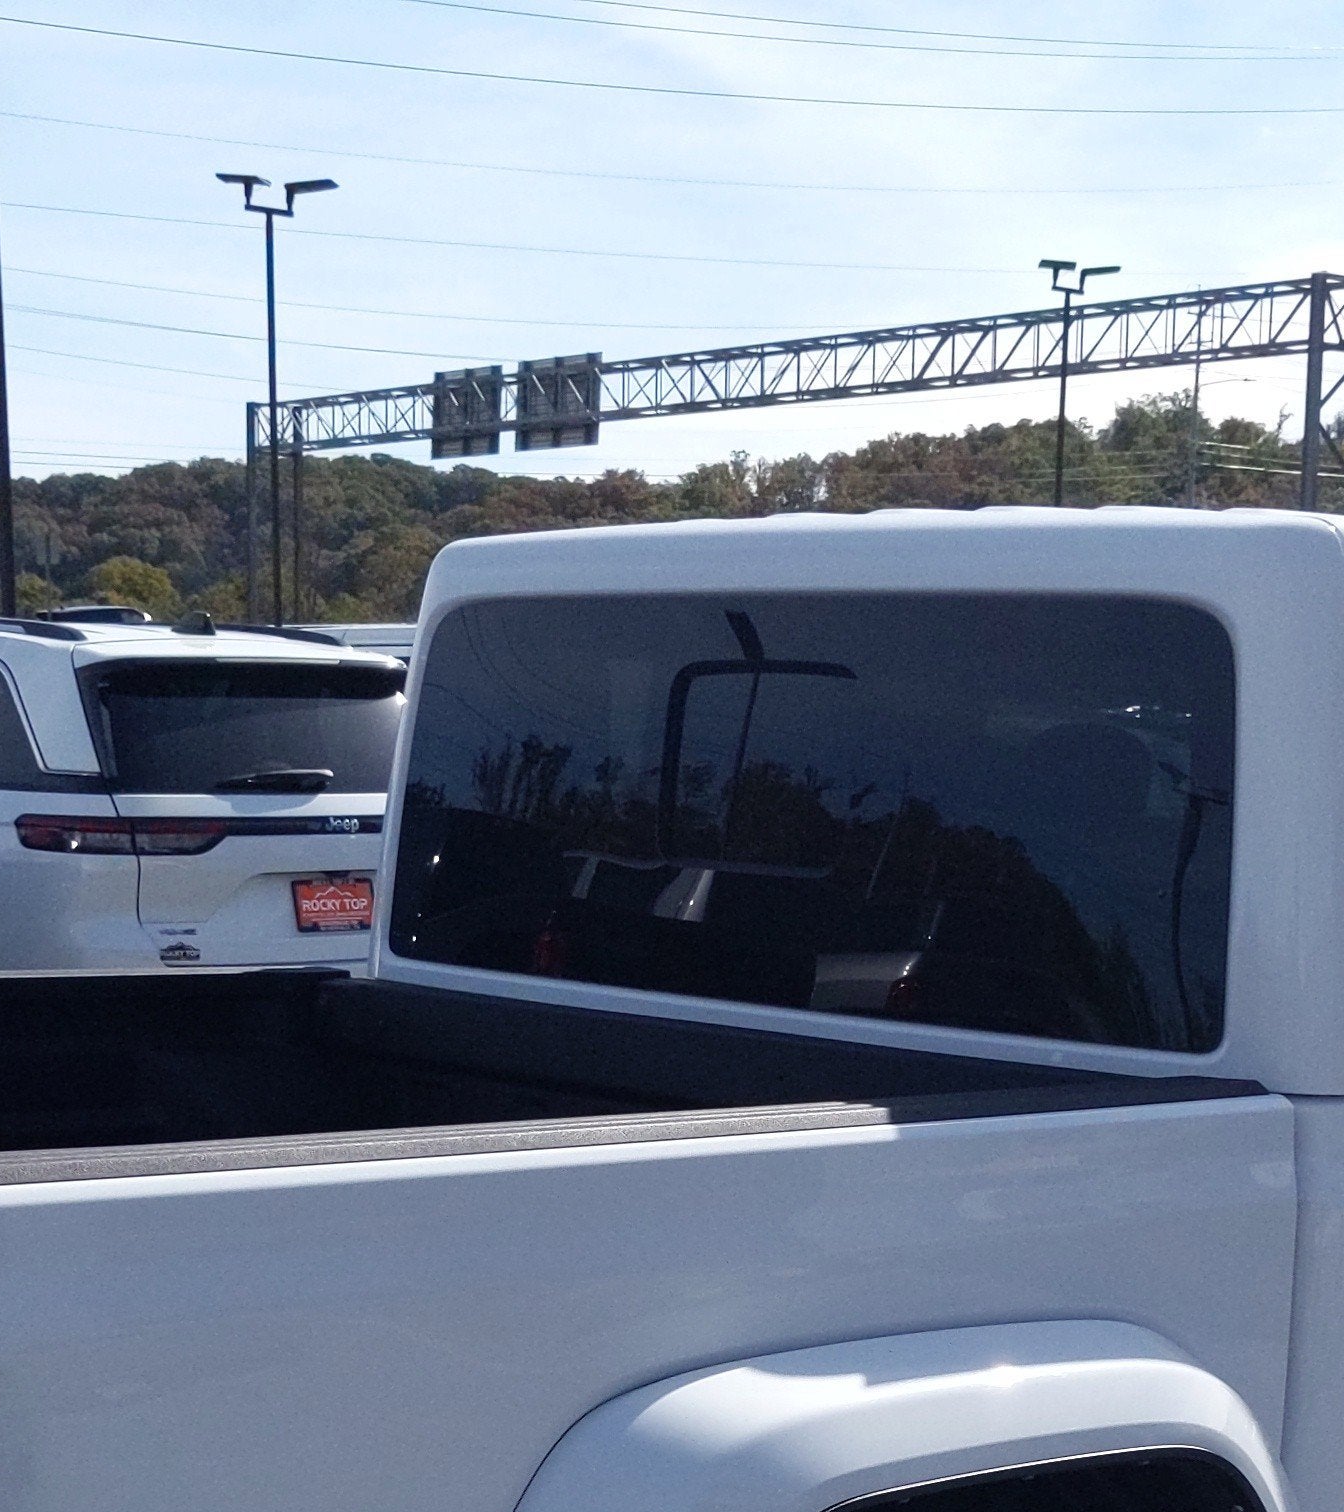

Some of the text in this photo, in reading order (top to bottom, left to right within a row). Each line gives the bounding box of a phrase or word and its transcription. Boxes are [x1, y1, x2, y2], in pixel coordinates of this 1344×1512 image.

[326, 816, 360, 833] Jeep
[302, 898, 368, 912] ROCKY TOP
